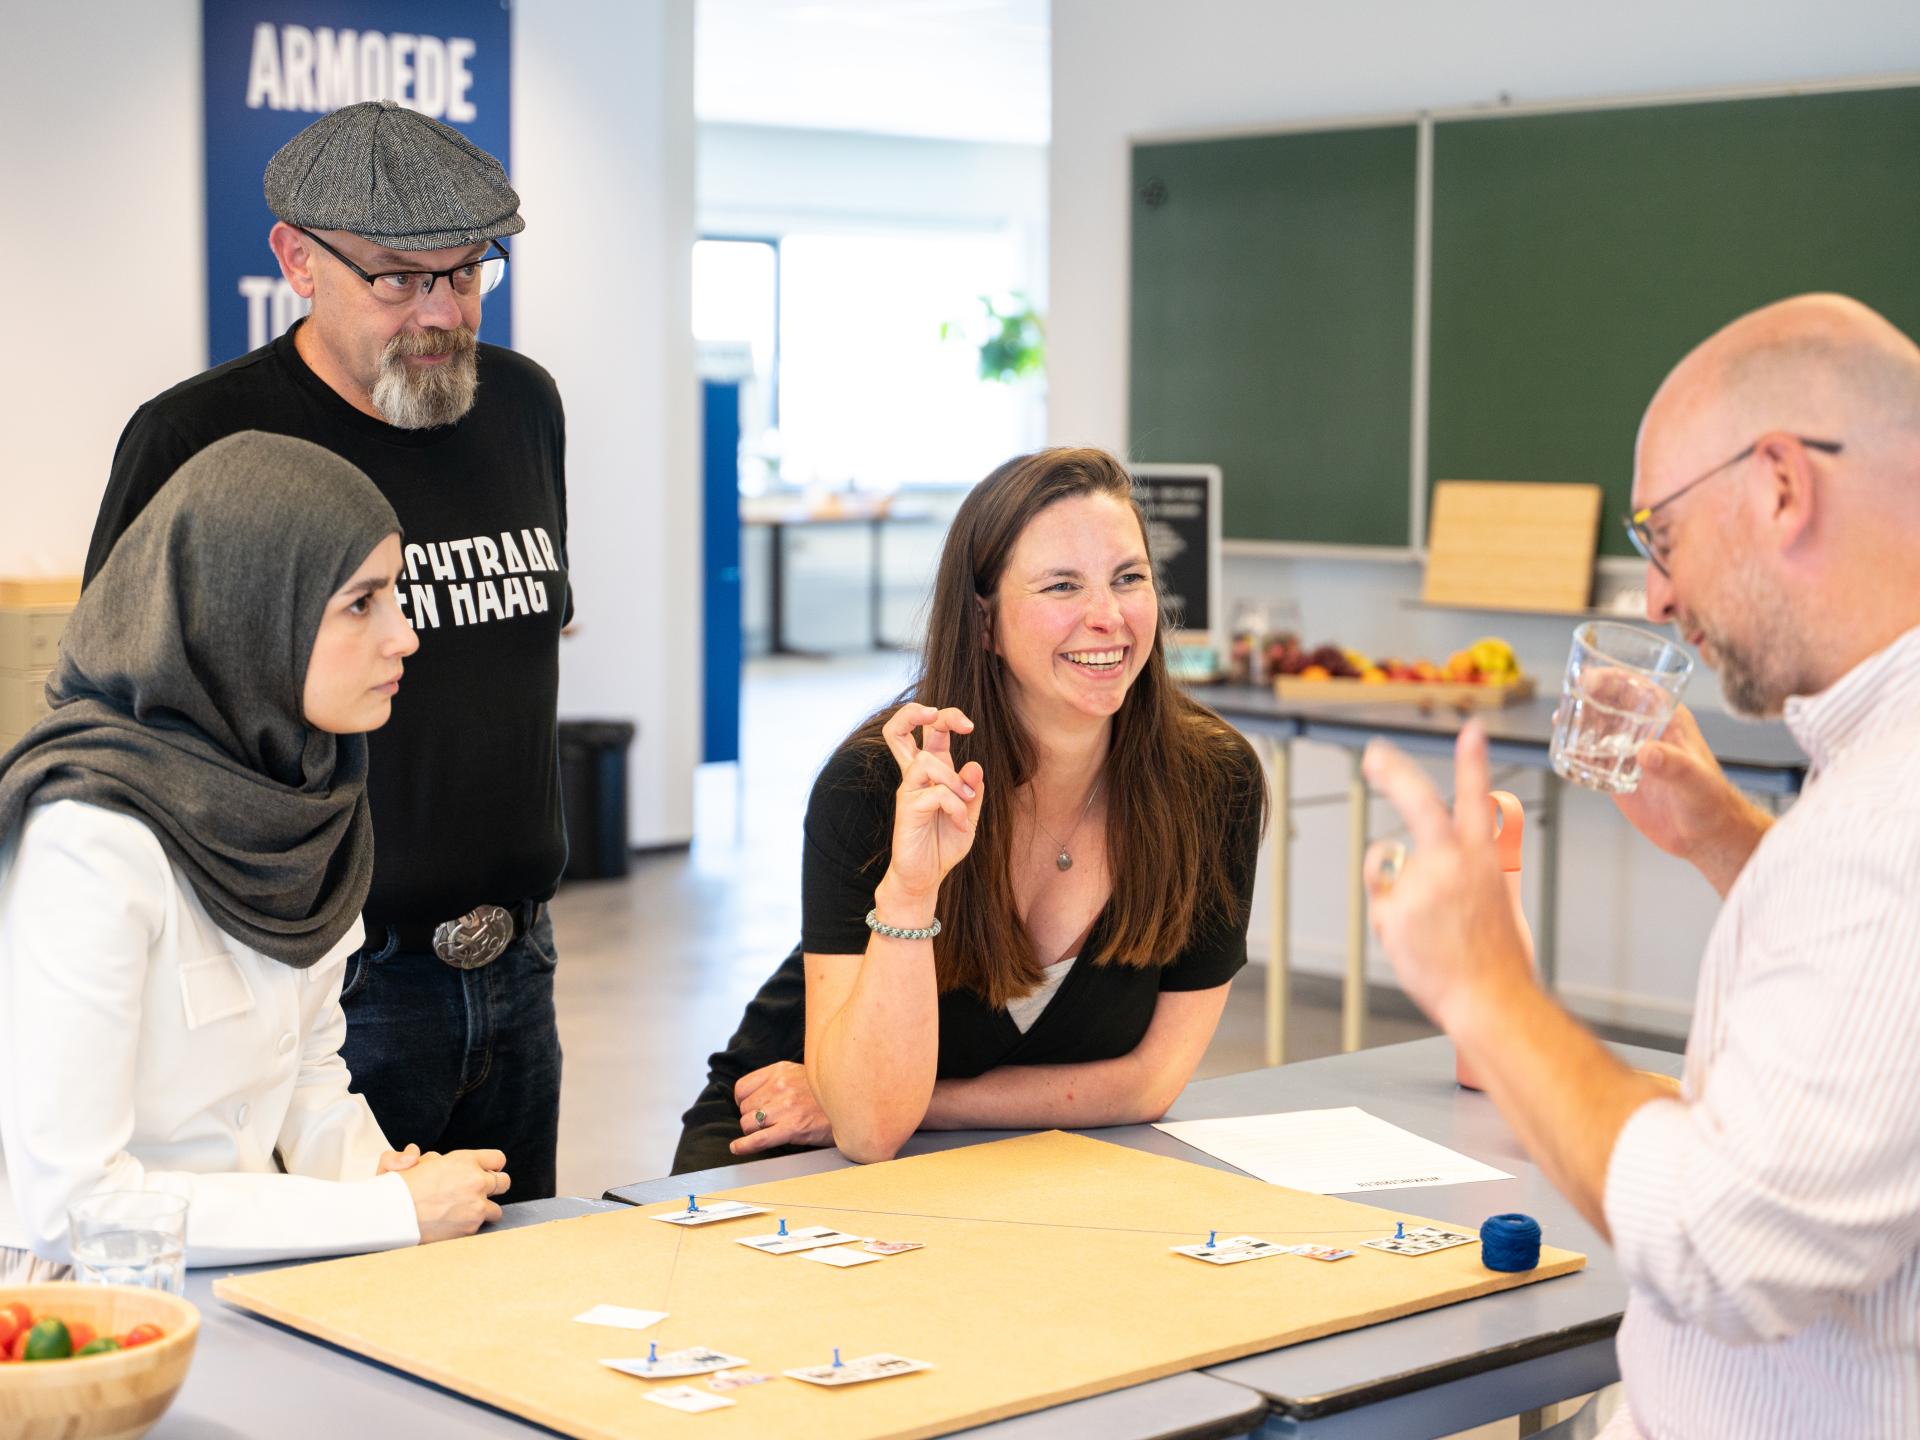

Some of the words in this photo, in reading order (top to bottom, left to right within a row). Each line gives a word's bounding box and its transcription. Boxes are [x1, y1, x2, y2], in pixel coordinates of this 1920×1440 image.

[246, 22, 477, 123] ARMOEDE
[238, 275, 312, 353] TO
[448, 576, 548, 626] HAAG
